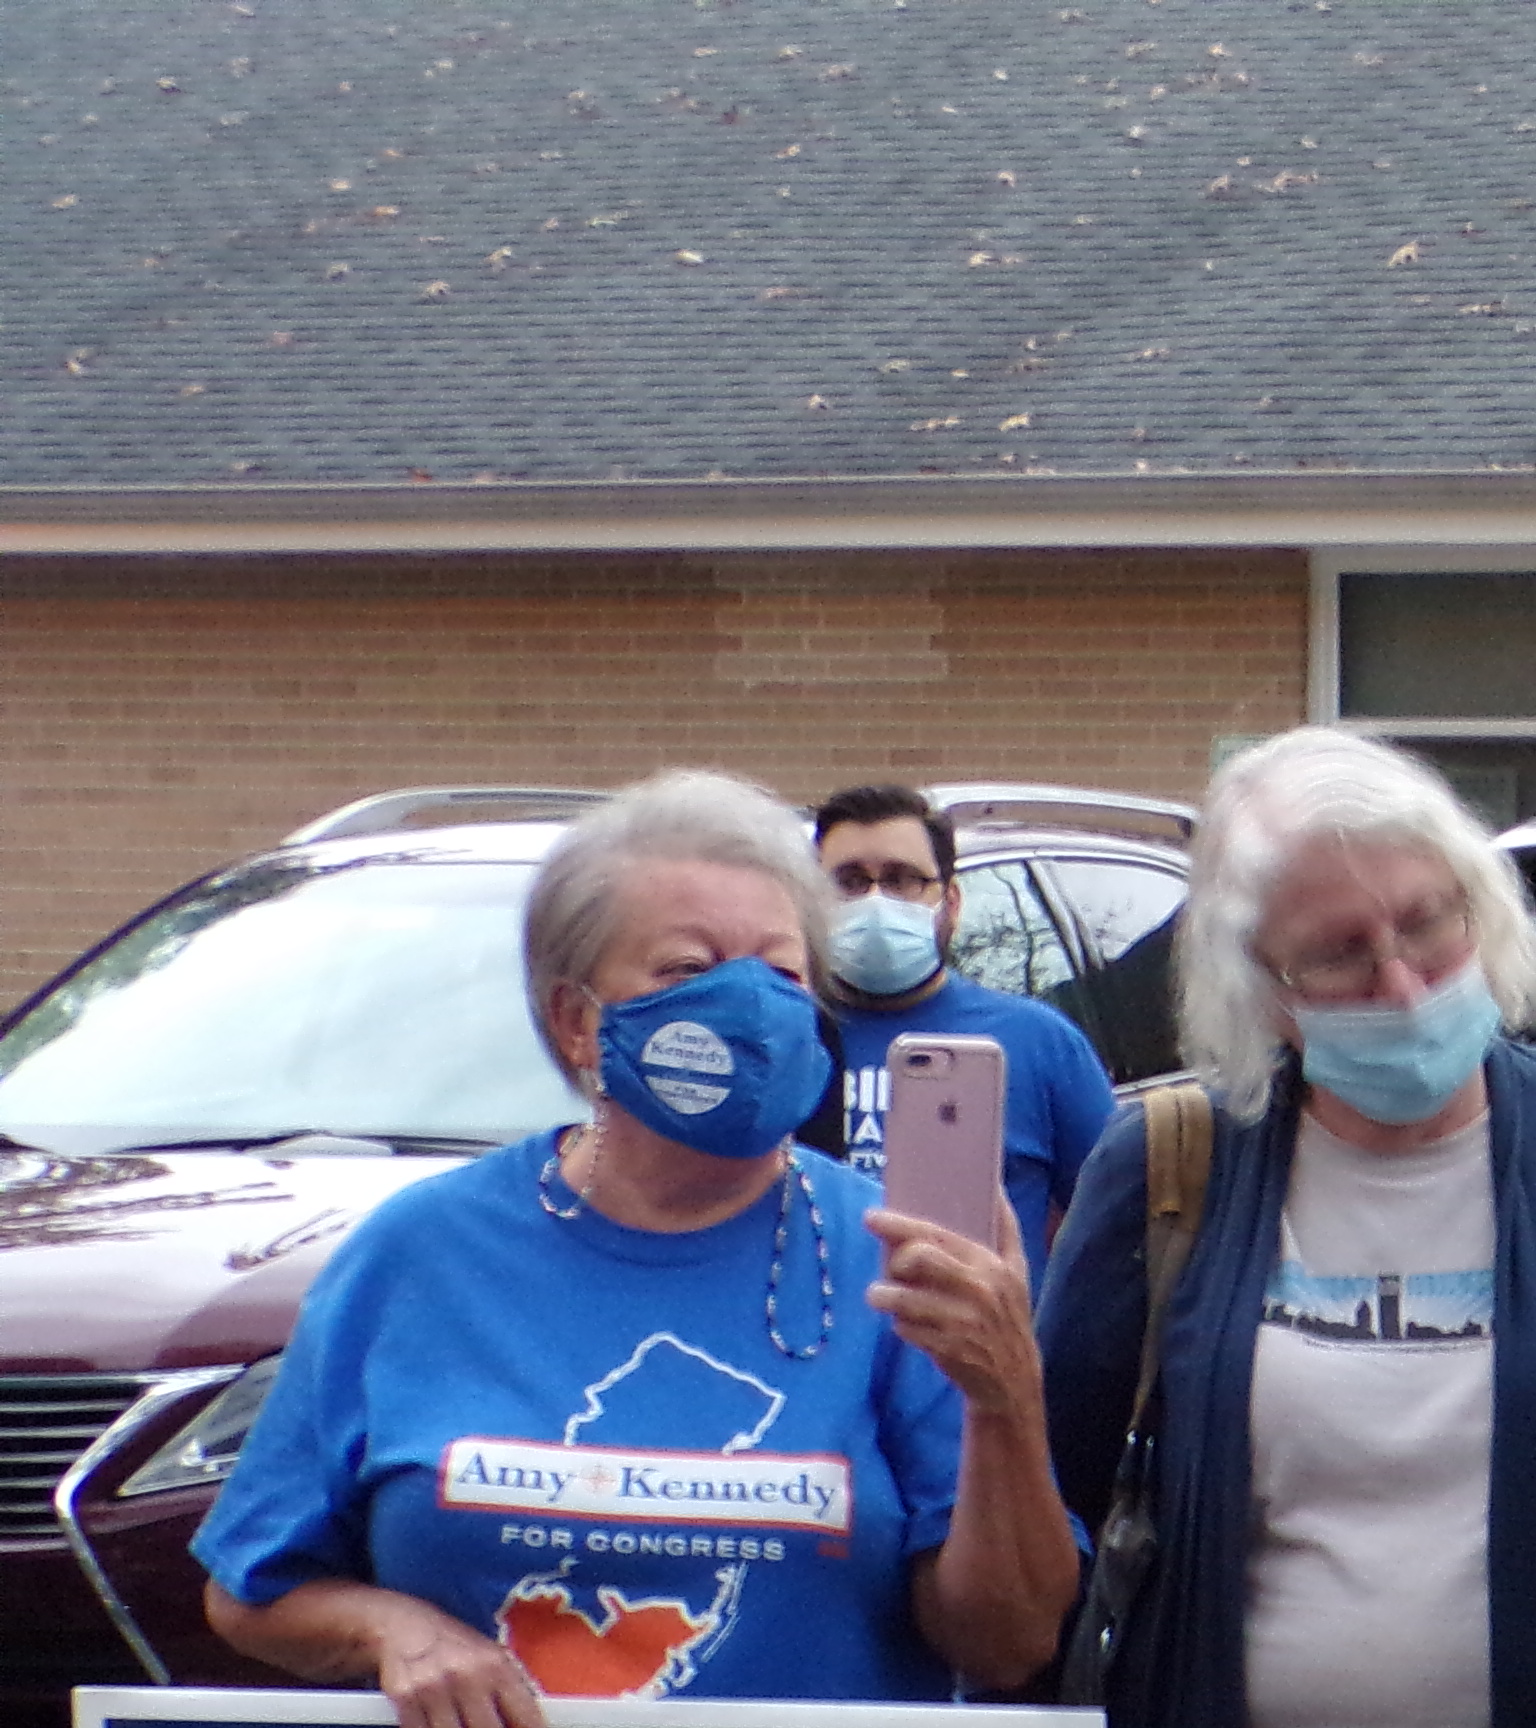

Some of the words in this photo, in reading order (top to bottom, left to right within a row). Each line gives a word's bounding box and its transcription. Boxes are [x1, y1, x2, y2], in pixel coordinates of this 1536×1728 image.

[457, 1450, 574, 1501] Amy
[615, 1465, 836, 1519] Kennedy
[501, 1523, 573, 1549] FOR
[586, 1531, 786, 1562] CONGRESS
